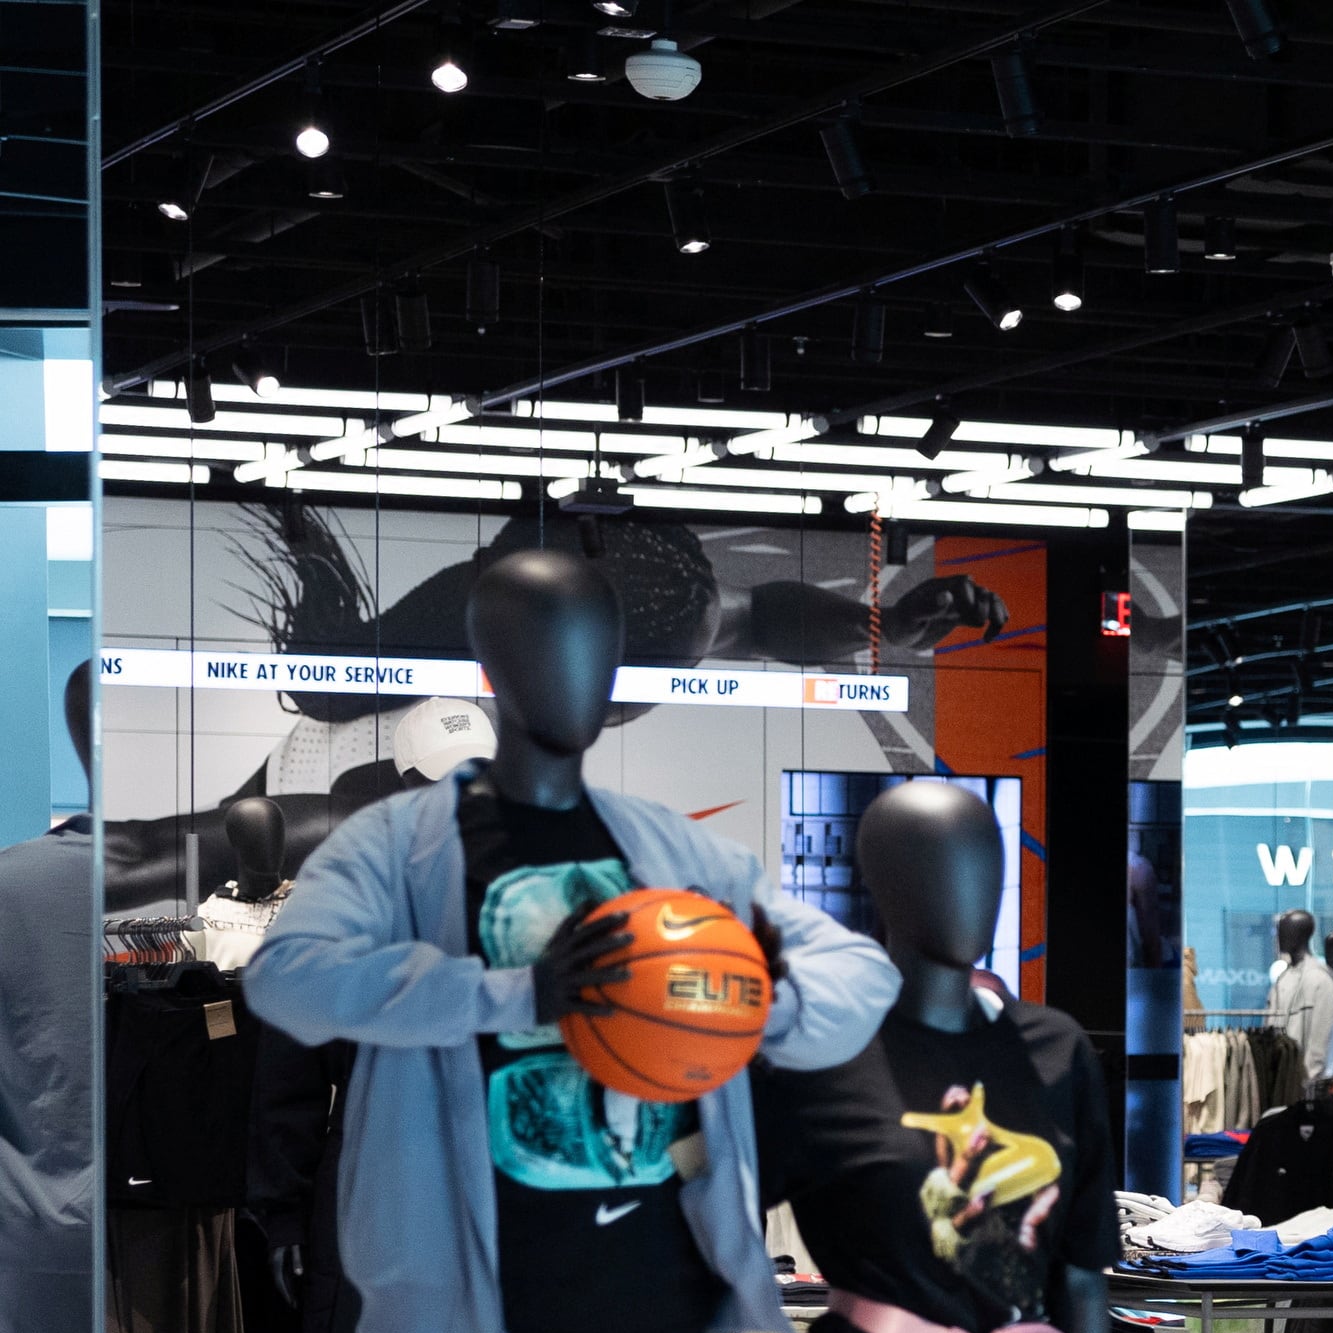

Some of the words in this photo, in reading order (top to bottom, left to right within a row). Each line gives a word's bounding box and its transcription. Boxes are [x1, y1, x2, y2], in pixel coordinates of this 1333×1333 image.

[207, 661, 248, 679] NIKE
[256, 664, 281, 680] AT
[288, 664, 336, 682] YOUR
[344, 666, 414, 684] SERVICE
[671, 677, 708, 694] PICK
[717, 680, 739, 695] UP
